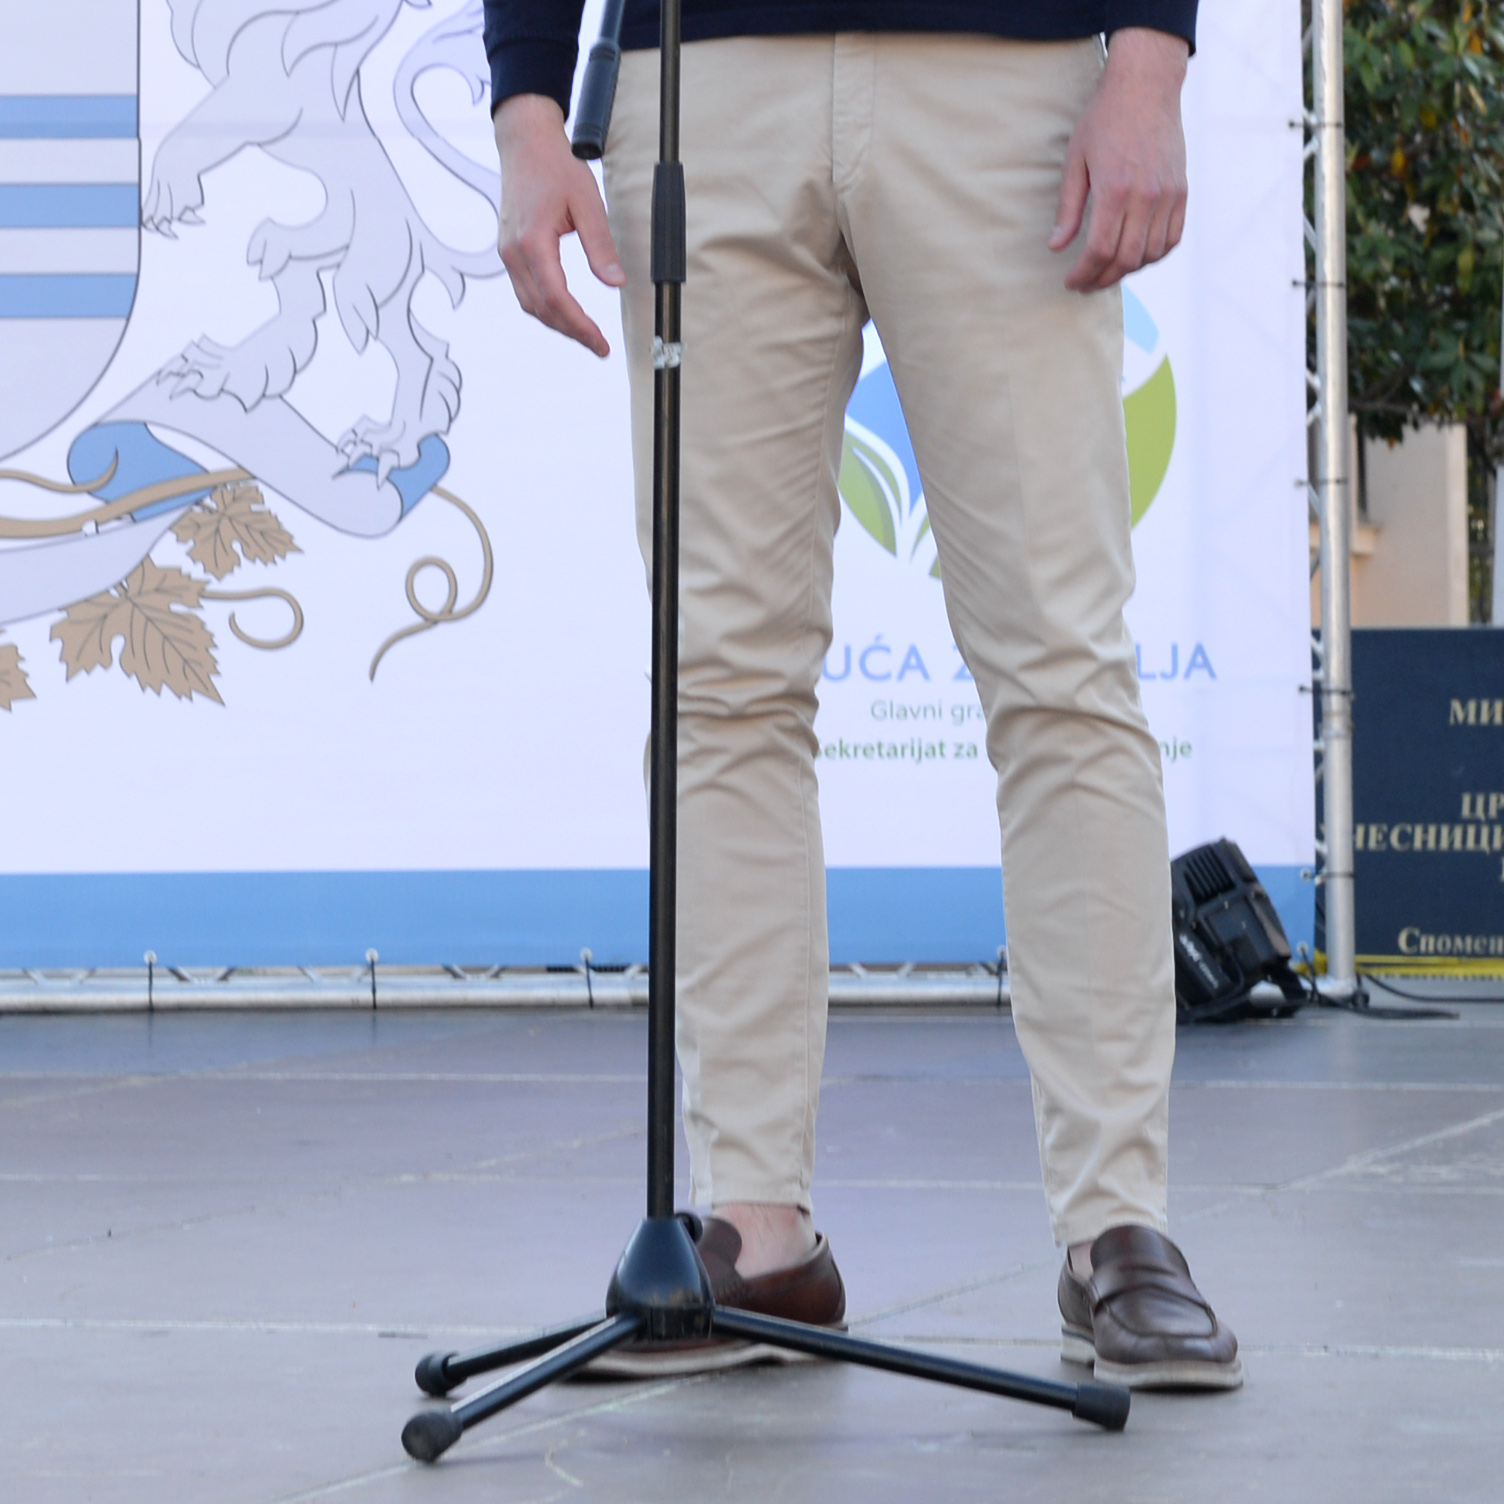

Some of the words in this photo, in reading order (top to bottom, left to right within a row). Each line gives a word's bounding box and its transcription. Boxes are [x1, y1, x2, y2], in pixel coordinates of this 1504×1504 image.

[822, 634, 931, 681] UĆA
[870, 699, 942, 721] Glavni
[953, 745, 978, 759] za
